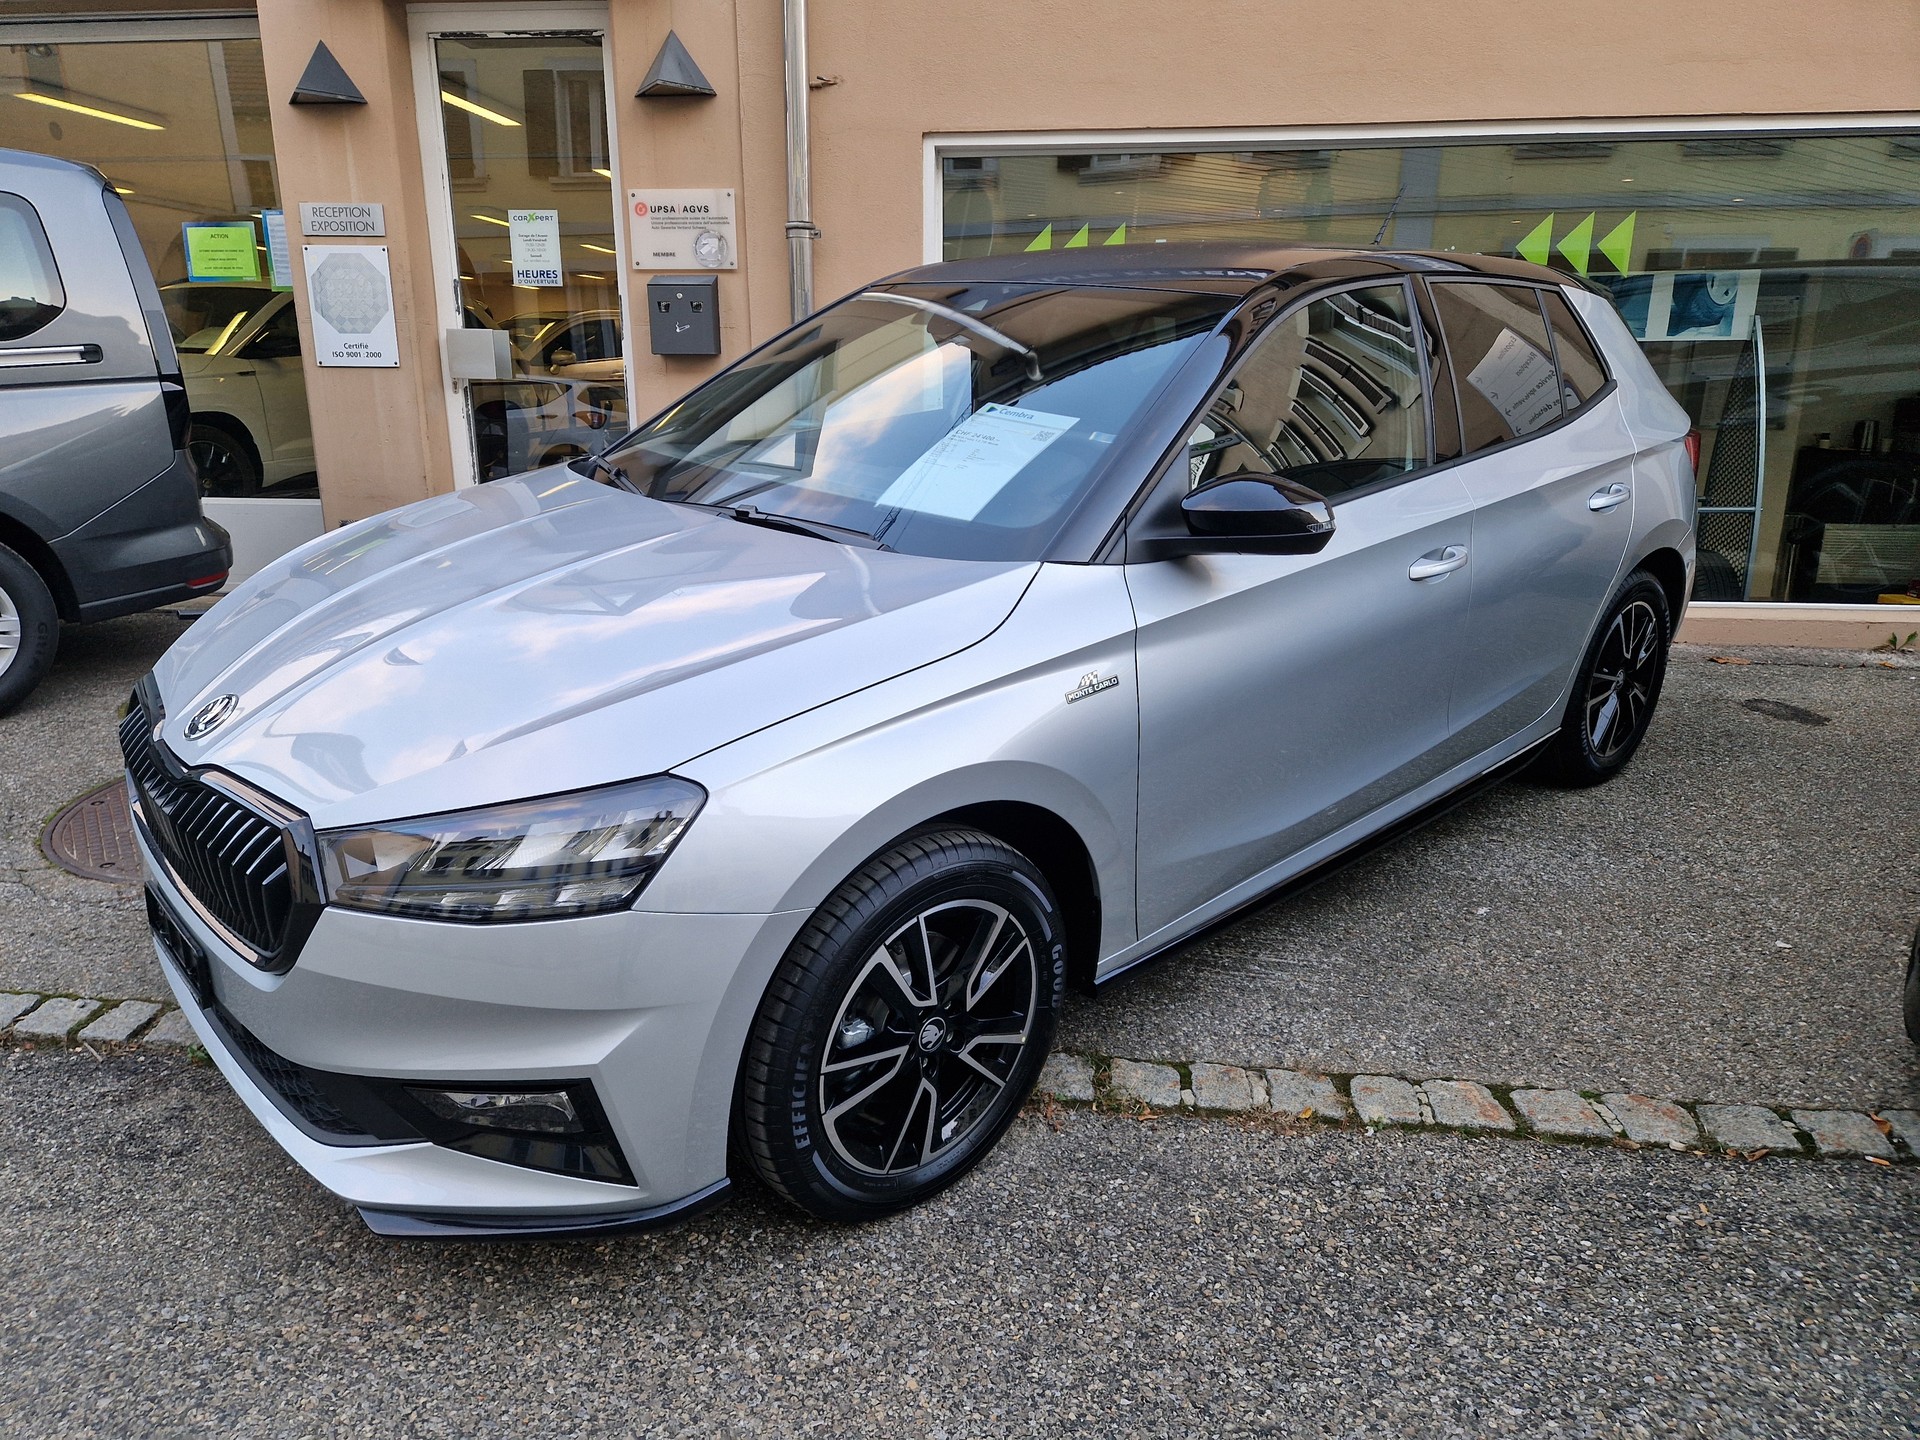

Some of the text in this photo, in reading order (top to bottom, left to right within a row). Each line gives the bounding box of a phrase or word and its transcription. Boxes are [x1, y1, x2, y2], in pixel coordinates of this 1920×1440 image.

[311, 206, 371, 218] RECEPTION
[650, 205, 709, 213] UPSA AGVS
[311, 220, 375, 232] EXPOSITION
[517, 269, 558, 279] HEURES
[343, 342, 369, 350] Certifié
[999, 408, 1035, 420] Cembra
[1067, 677, 1118, 701] MONTE CARLO
